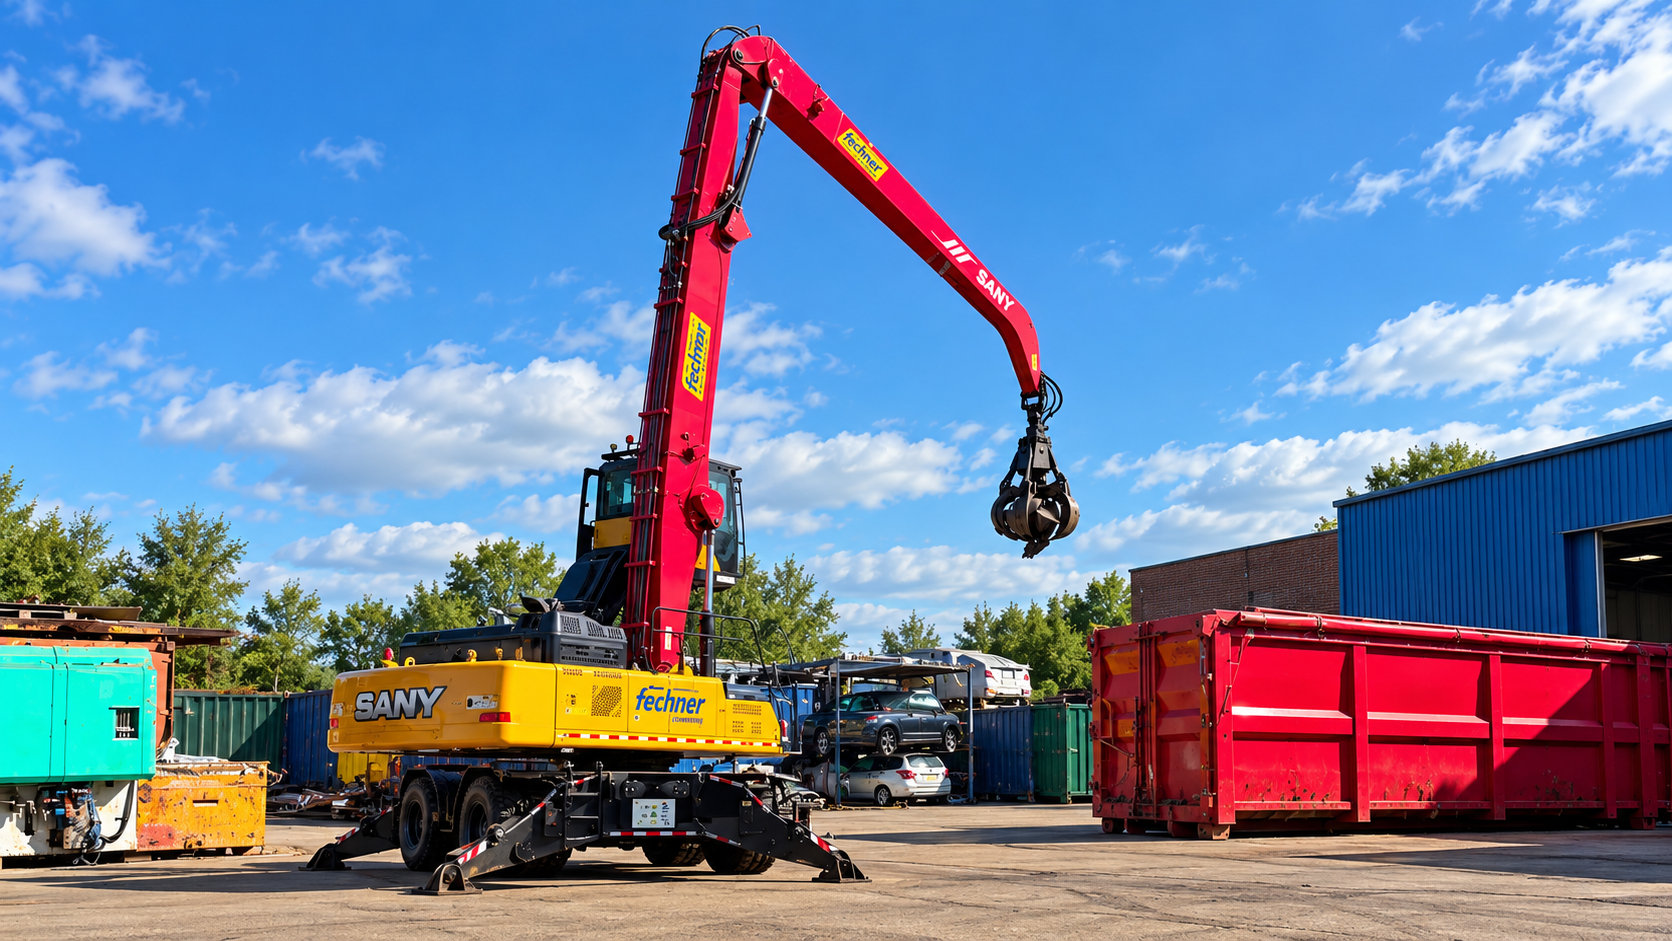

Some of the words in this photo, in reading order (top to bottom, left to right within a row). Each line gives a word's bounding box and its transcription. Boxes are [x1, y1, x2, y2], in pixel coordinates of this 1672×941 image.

[976, 269, 1015, 311] SANY
[354, 685, 447, 722] SANY
[635, 687, 706, 714] fechner
